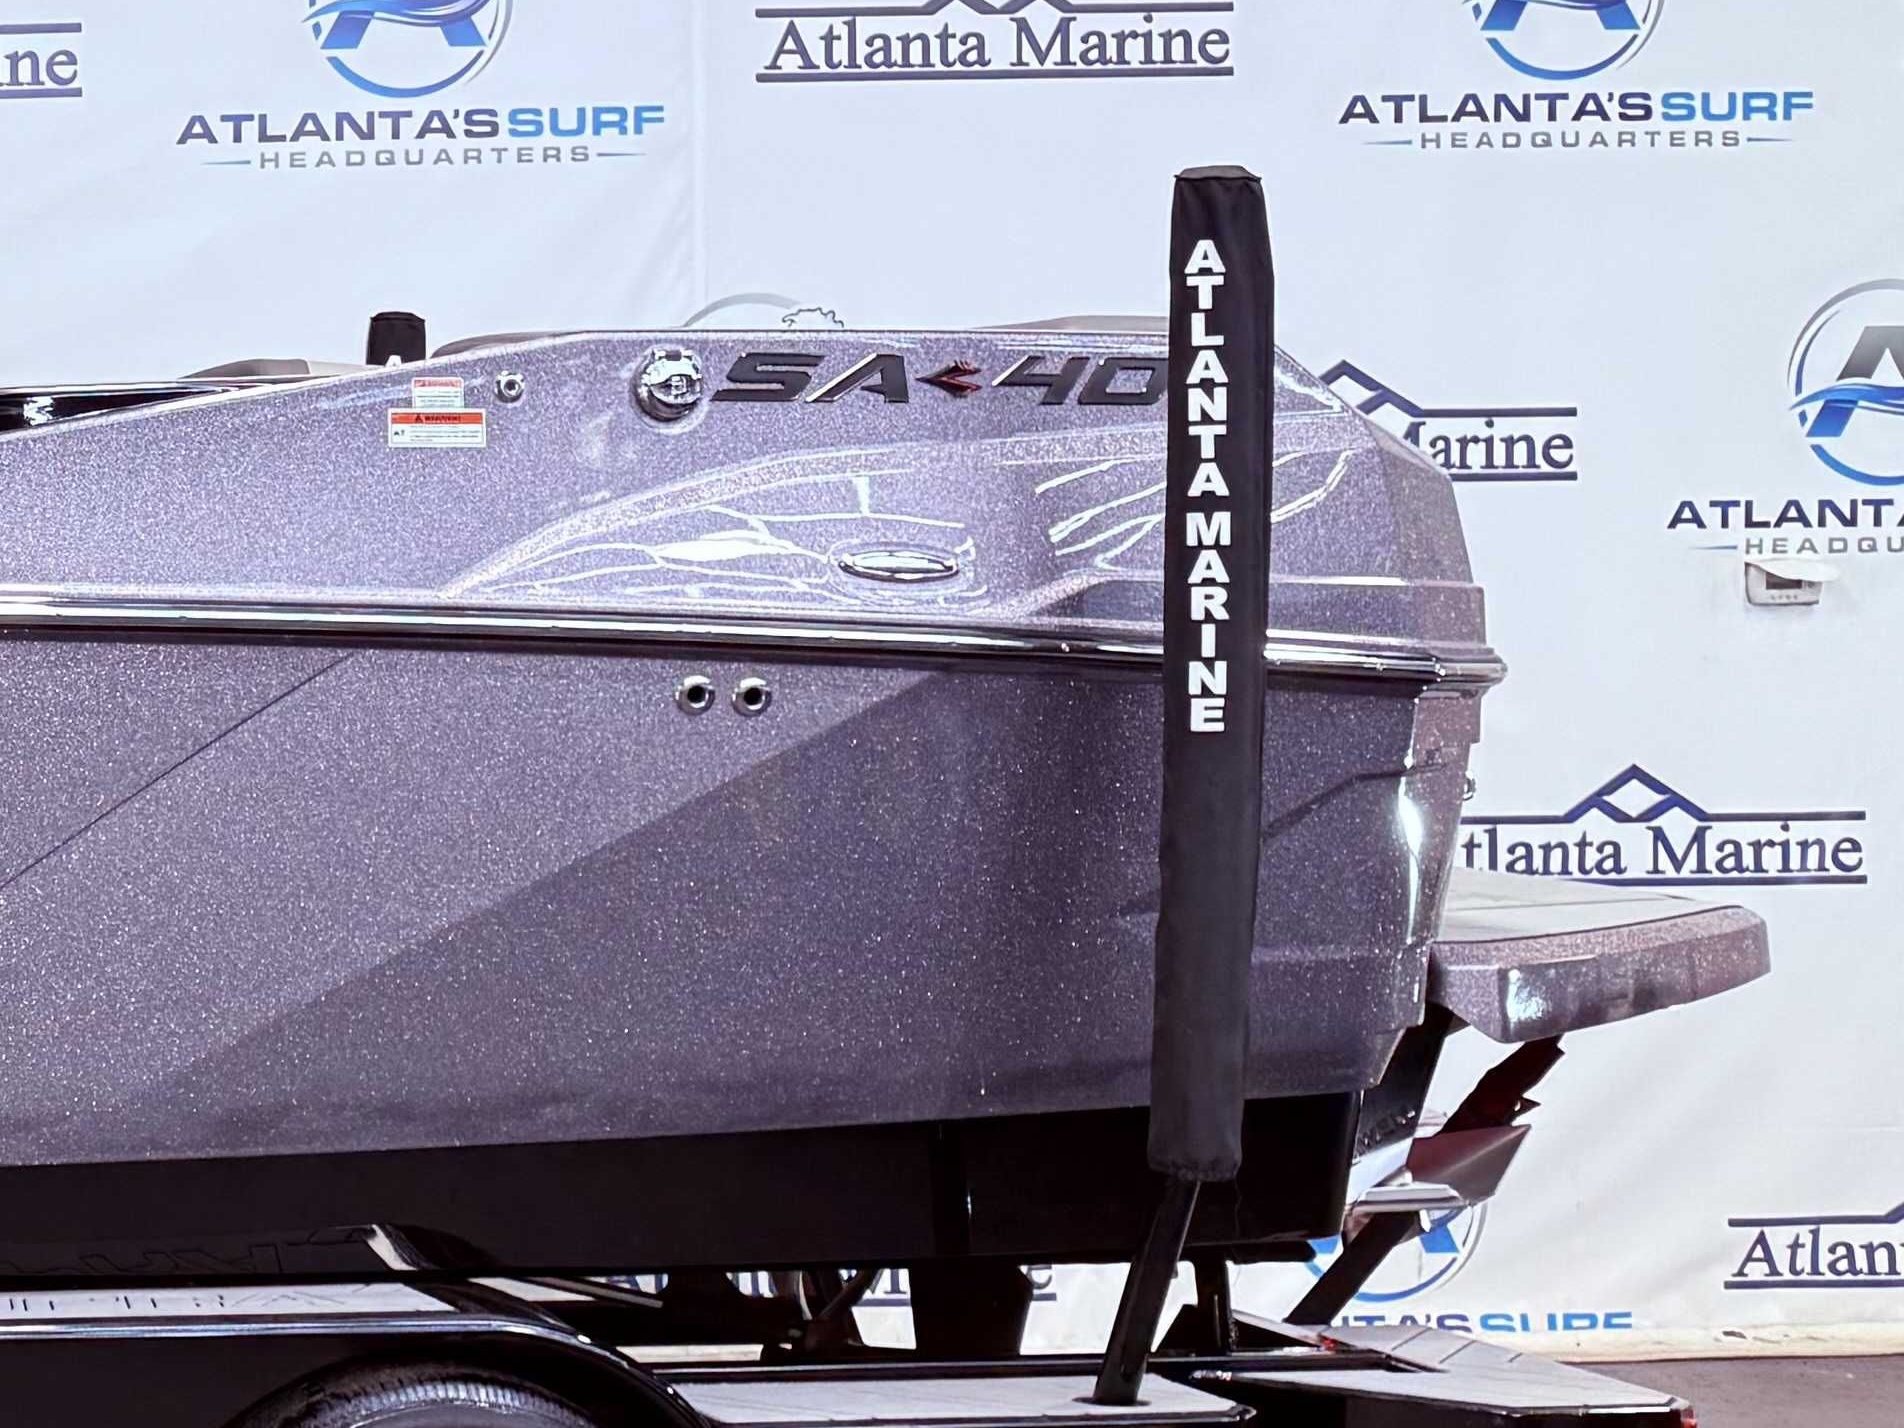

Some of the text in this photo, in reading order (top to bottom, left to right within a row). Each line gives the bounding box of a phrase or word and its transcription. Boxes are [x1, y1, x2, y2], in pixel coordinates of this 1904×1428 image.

[763, 12, 1230, 71] Atlanta Marine
[259, 142, 589, 169] HEADQUARTERS
[1421, 131, 1739, 149] HEADQUARTERS
[710, 351, 910, 404] SA
[1183, 239, 1229, 733] ATLANTA MARINE
[1666, 498, 1904, 530] ATLANT
[1459, 821, 1863, 877] tlanta Marine
